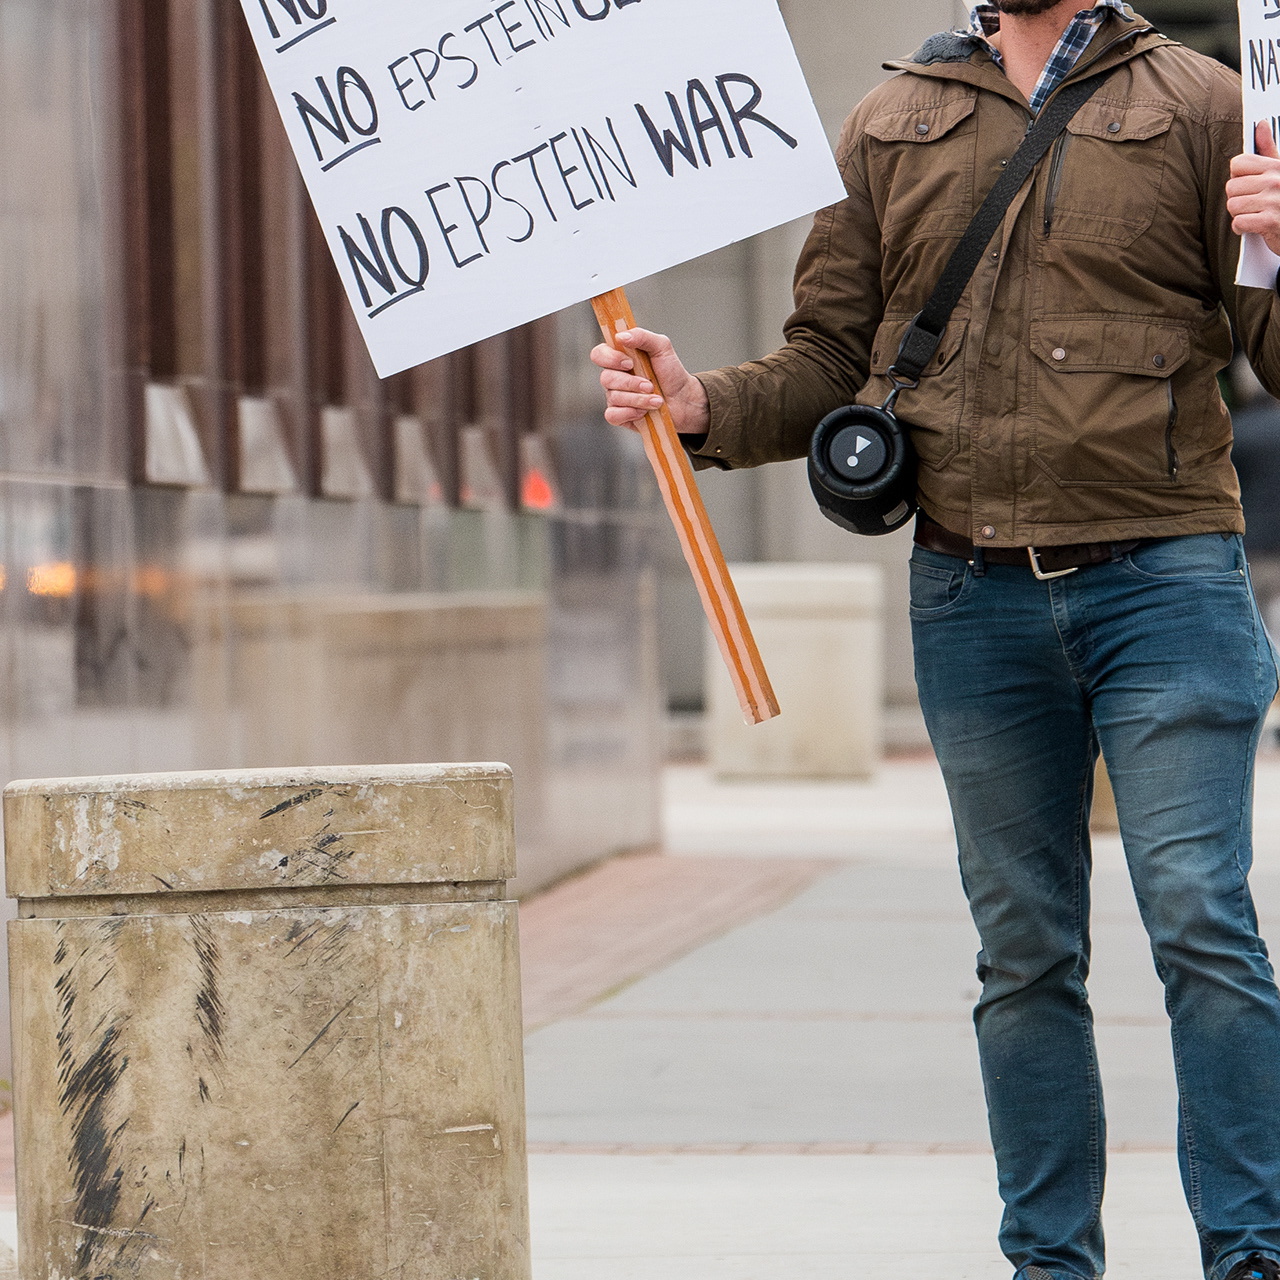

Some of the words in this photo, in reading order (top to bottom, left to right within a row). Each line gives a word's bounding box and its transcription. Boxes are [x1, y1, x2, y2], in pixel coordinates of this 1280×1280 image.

[292, 65, 378, 161] NO
[337, 207, 429, 307] NO
[425, 117, 636, 268] EPSTEIN
[634, 73, 797, 177] WAR
